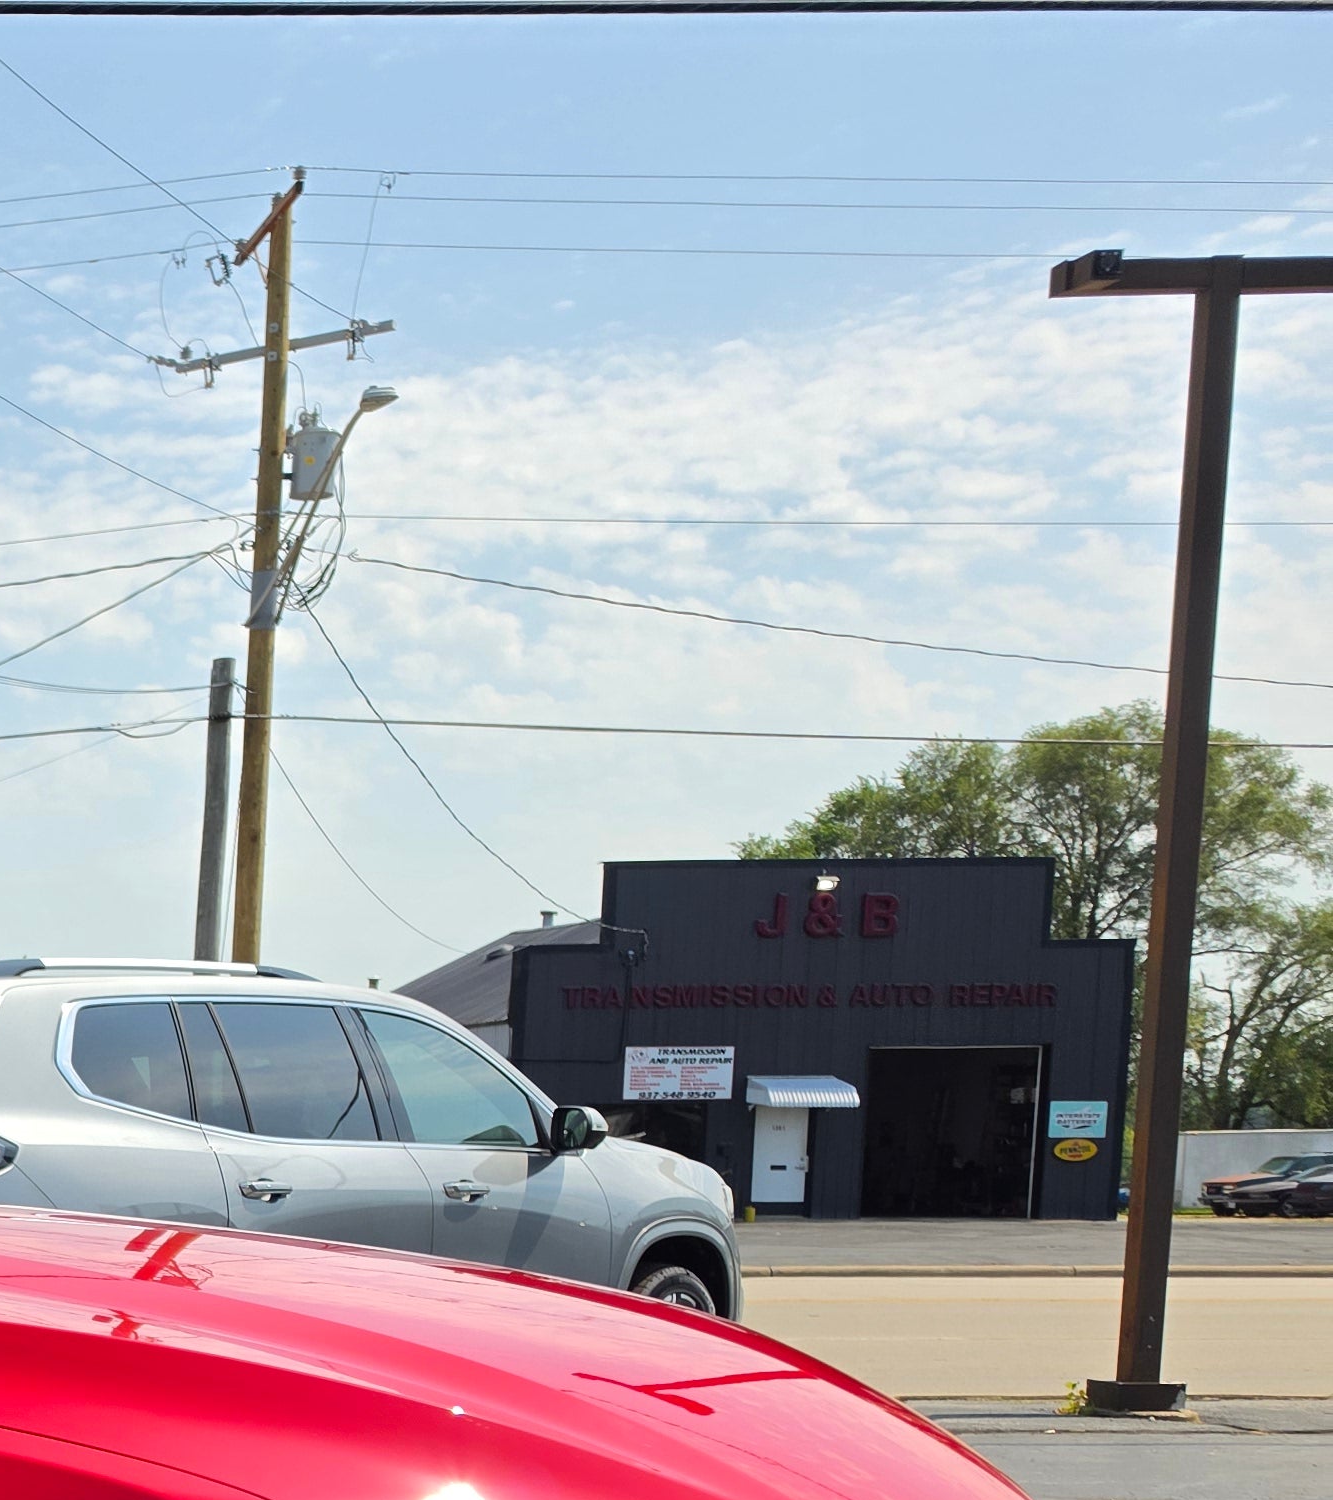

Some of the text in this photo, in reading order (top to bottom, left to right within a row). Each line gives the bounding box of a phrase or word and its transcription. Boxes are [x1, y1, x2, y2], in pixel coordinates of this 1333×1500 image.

[754, 891, 899, 938] J & B
[562, 983, 1058, 1010] TRANSMISSION & AUTO REPAIR
